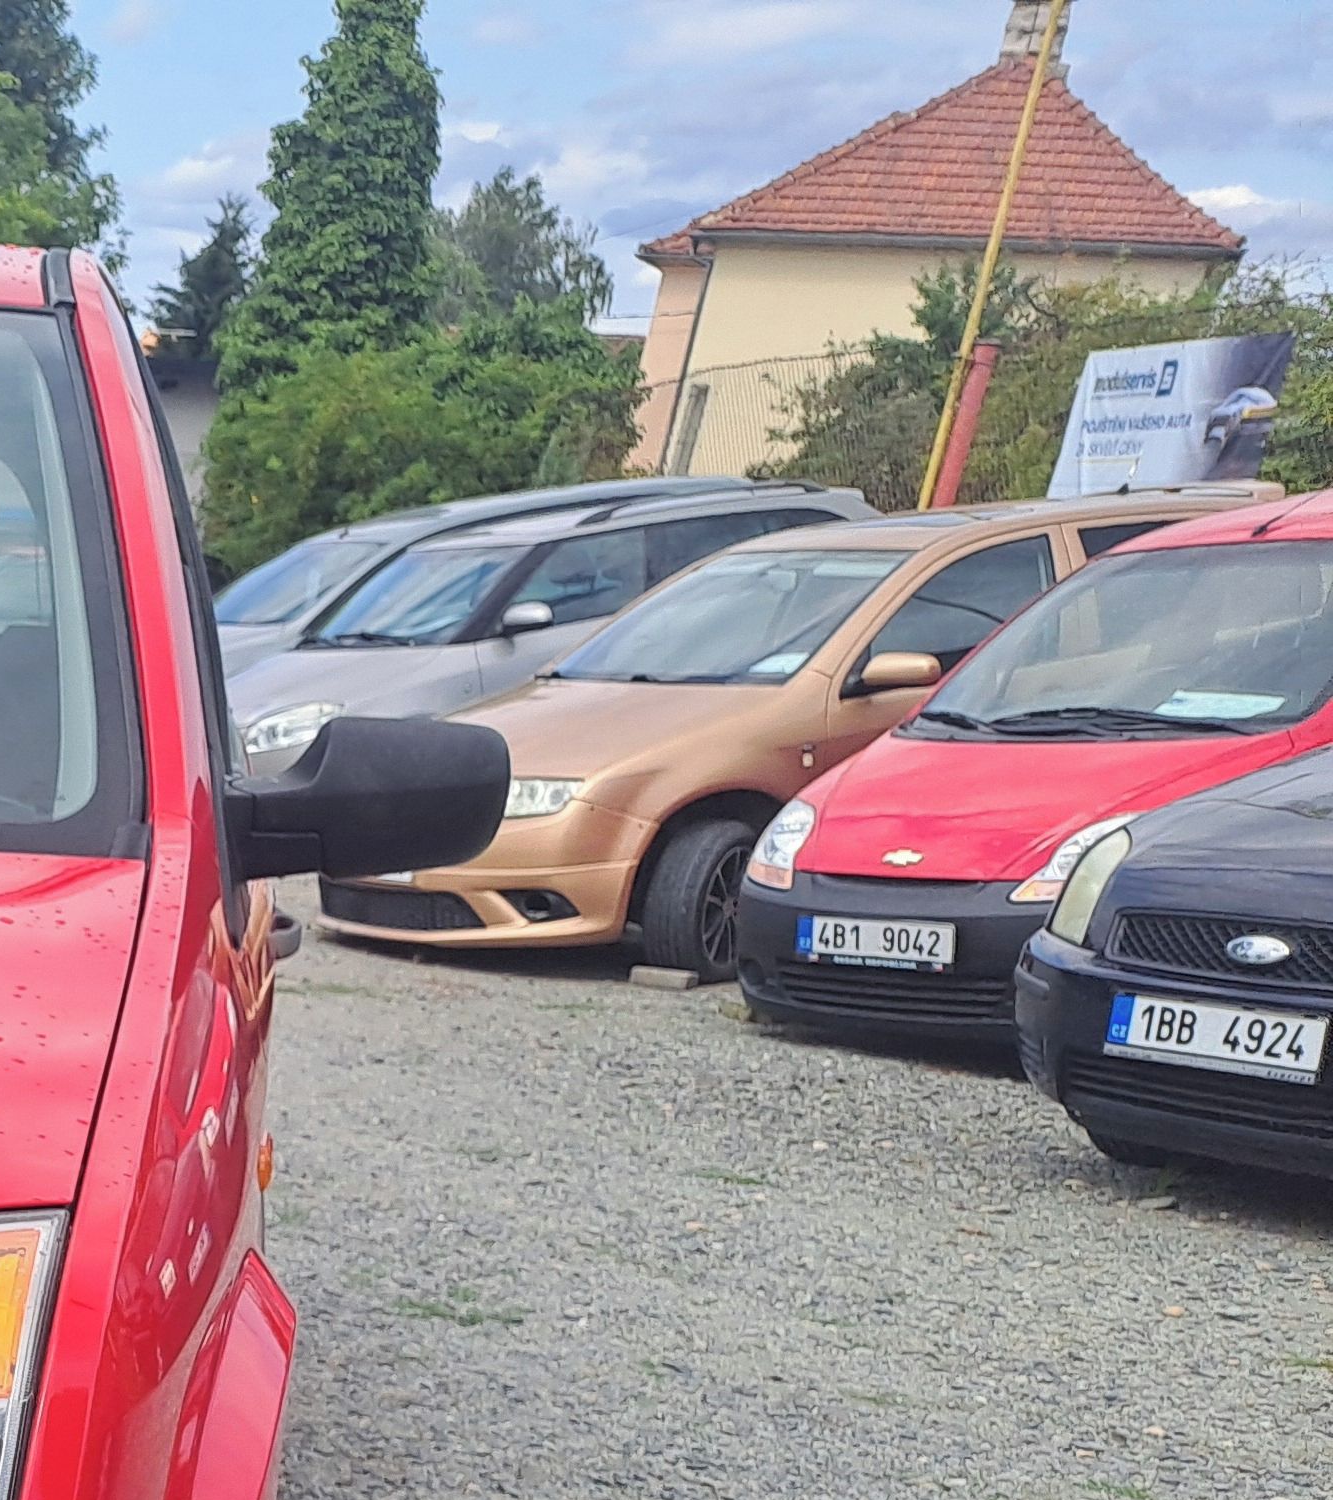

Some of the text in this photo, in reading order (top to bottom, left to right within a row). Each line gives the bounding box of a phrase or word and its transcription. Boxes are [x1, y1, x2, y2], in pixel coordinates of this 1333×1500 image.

[818, 922, 861, 951] 4B1
[882, 927, 941, 958] 9042
[1111, 1004, 1306, 1062] CZ 1BB 4924
